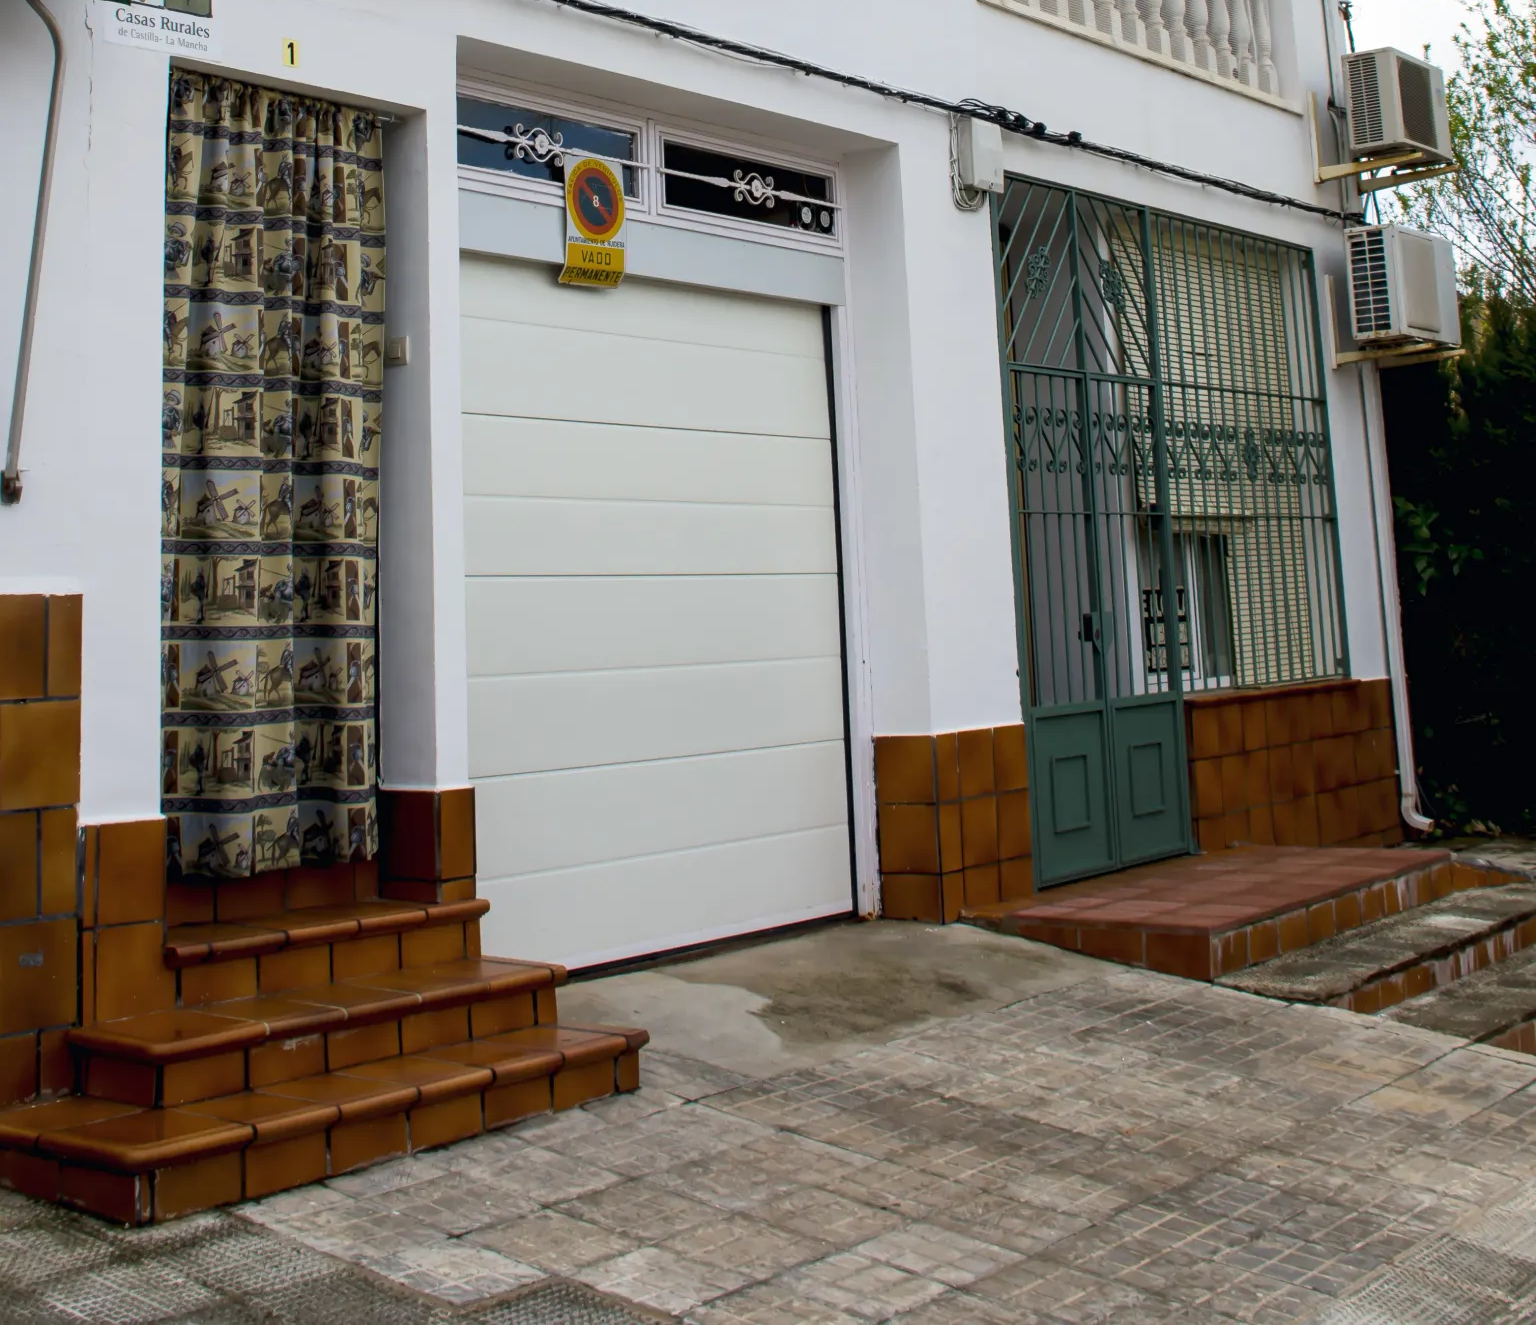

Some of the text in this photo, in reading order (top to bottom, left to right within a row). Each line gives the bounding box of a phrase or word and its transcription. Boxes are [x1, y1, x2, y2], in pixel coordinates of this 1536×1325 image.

[115, 8, 210, 39] Casas Rurales
[118, 27, 128, 36] de
[165, 36, 175, 46] La
[177, 38, 208, 52] Mancha
[287, 42, 295, 65] 1
[567, 166, 582, 195] SALIDA
[592, 195, 600, 208] 8
[568, 236, 599, 246] AYUNTAMIENTO
[599, 239, 606, 247] DE
[581, 249, 612, 266] VADO
[561, 266, 624, 283] PERMANENTE
